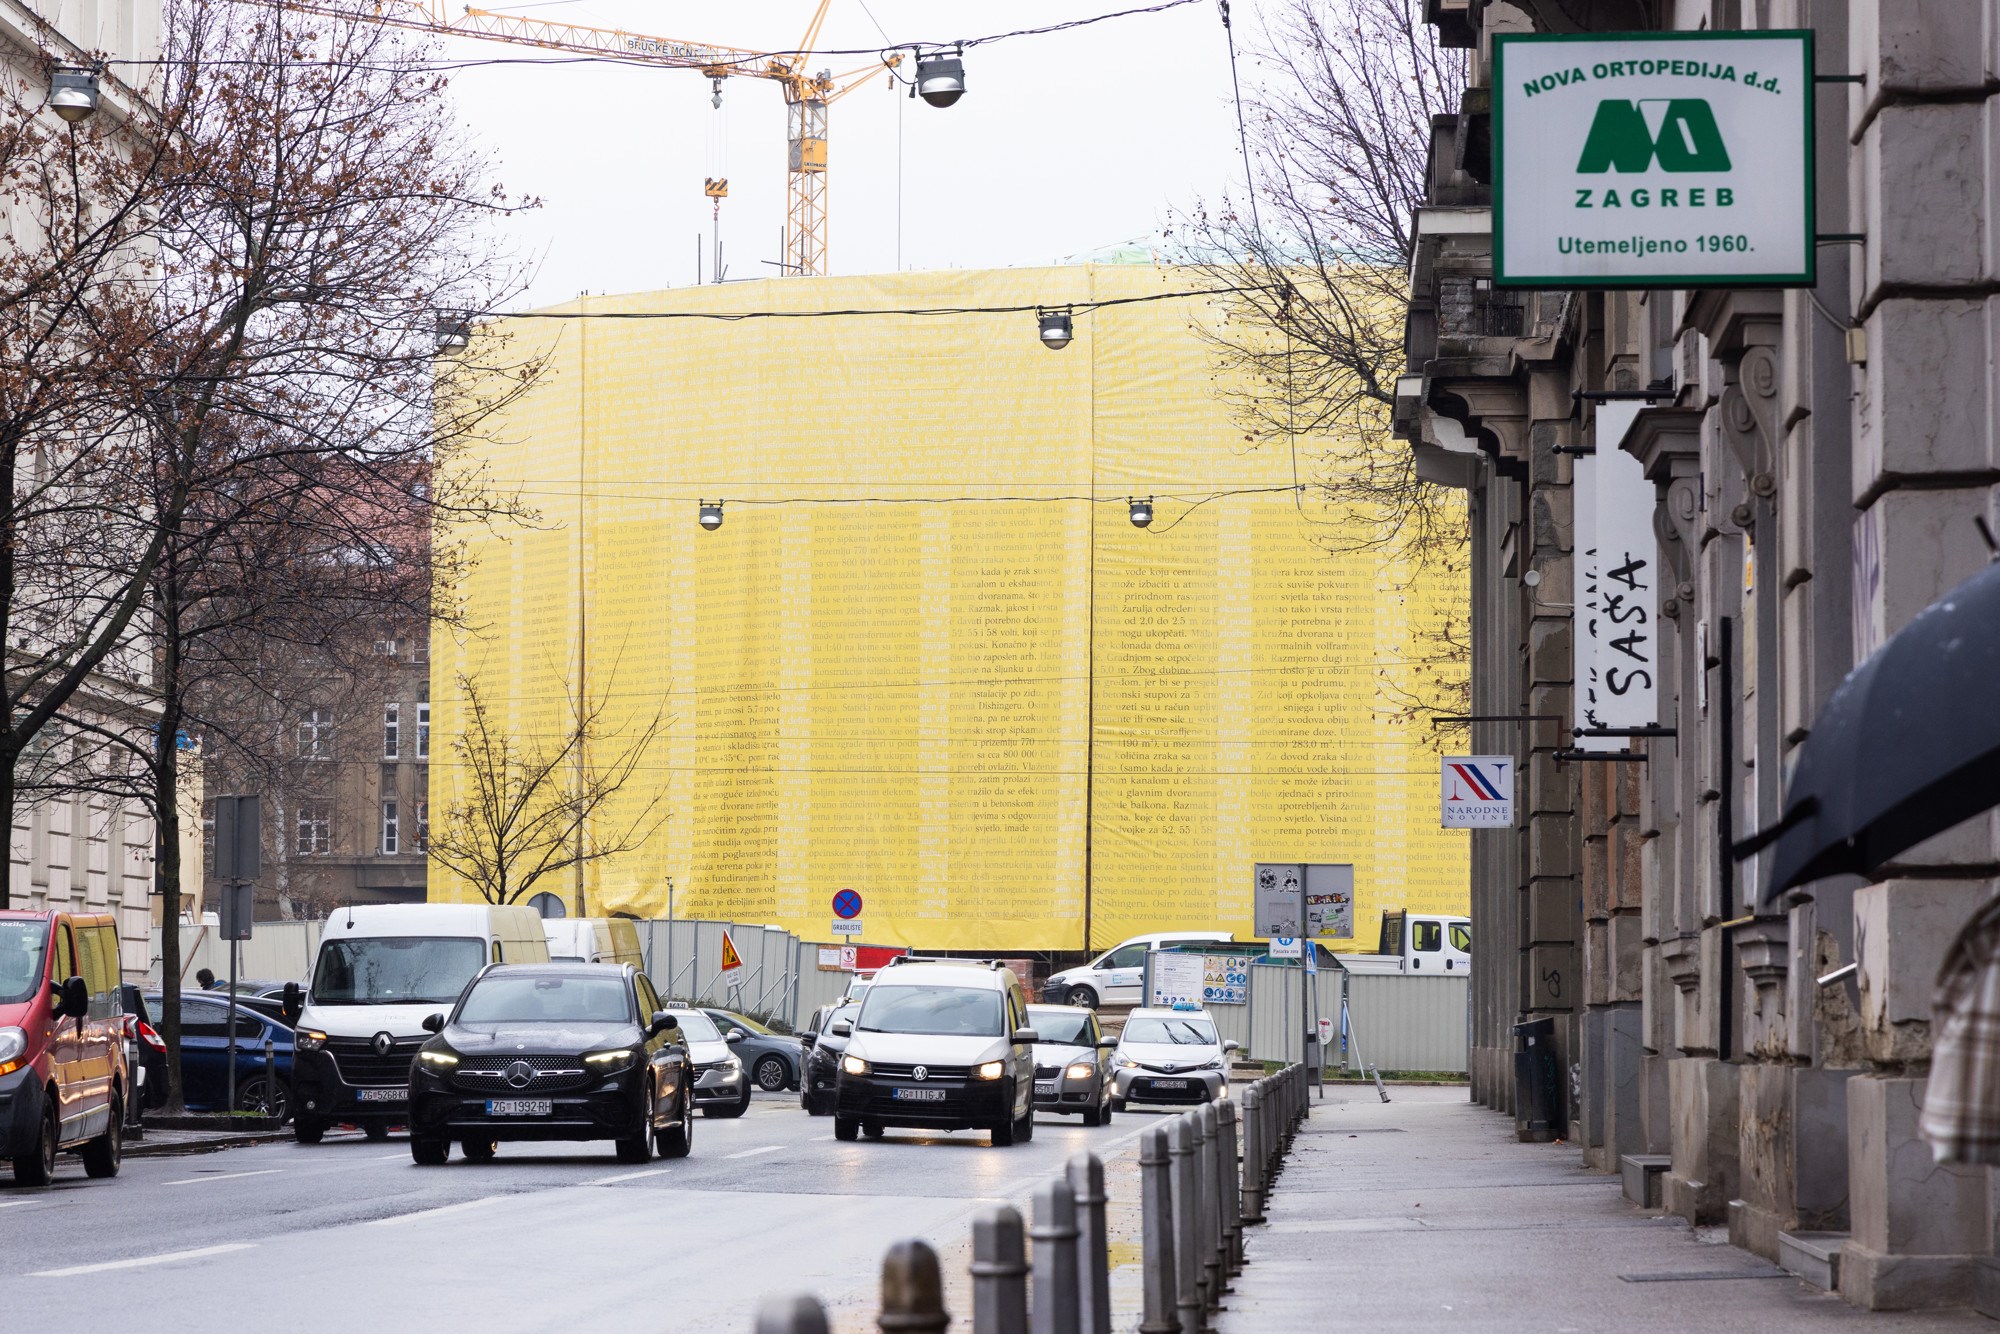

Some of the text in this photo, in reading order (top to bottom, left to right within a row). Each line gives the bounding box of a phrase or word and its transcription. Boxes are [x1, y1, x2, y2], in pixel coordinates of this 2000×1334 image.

[1523, 60, 1782, 97] NOVA ORTOPEDIJA d.d.
[1575, 188, 1734, 208] ZAGREB
[1558, 234, 1755, 257] Utemeljeno 1960.
[981, 567, 1030, 575] kada zrak
[1125, 567, 1170, 577] vode koju
[1294, 568, 1345, 576] kroz sistem
[961, 579, 996, 587] kanalom
[1112, 579, 1170, 587] može izbaciti
[1286, 580, 1355, 590] suviše pokvaren
[978, 590, 1040, 601] dvoranama, što
[1124, 592, 1173, 602] prirodnom
[1281, 592, 1332, 602] svjetla tako
[968, 603, 1029, 614] Razmak, jakost
[1122, 604, 1152, 614] žarulja
[1291, 605, 1343, 613] tako vrsta
[984, 616, 1021, 626] potrebno
[1291, 617, 1331, 627] potrebna
[1601, 552, 1652, 696] SAŠA
[1022, 627, 1038, 638] koji
[1117, 629, 1187, 639] mogu ukopčati.
[1261, 629, 1334, 638] kružna dvorana
[991, 640, 1027, 648] Konačno
[1110, 641, 1181, 649] kolonada doma
[1265, 641, 1370, 650] normalnih volframovih
[983, 653, 1036, 663] zaposlen arh.
[1106, 653, 1208, 663] Gradnjom otpočelo
[1271, 654, 1361, 664] Razmjerno dugi rok
[994, 664, 1024, 675] šljunku
[1132, 665, 1191, 675] Zbog dubine
[1279, 666, 1350, 674] došlo obzir
[1144, 678, 1156, 688] jer
[1301, 678, 1347, 689] podrumu,
[969, 689, 1008, 699] instalacije
[1102, 690, 1177, 700] betonski stupovi
[1115, 702, 1190, 710] uzeti račun
[1283, 703, 1347, 713] snijega upliv
[1013, 713, 1049, 724] uzrokuje
[1287, 715, 1349, 725] svodova obiju
[986, 726, 1043, 736] strop šipkama
[1118, 727, 1137, 737] koje
[1256, 727, 1337, 736] ubetonirane doze.
[1003, 750, 1018, 758] 800
[1021, 750, 1037, 758] 000
[1114, 752, 1178, 760] količina zraka
[1280, 752, 1363, 760] dovod zraka služe
[1022, 762, 1057, 772] Vlaženje
[1120, 764, 1173, 774] (samo kada
[978, 774, 1030, 784] zatim prolazi
[1130, 776, 1170, 784] kanalom
[1294, 776, 1353, 785] može izbaciti
[1126, 788, 1163, 798] glavnim
[1275, 789, 1373, 799] izjednači prirodnom
[720, 801, 754, 809] dvorane
[990, 799, 1034, 807] betonskom
[1277, 801, 1370, 812] upotrebljenih žarulja
[1134, 813, 1197, 823] koje davati
[1285, 814, 1347, 824] svjetlo. Visina
[1004, 823, 1029, 831] imade
[1110, 825, 1146, 835] odvojke
[1273, 826, 1367, 836] prema potrebi mogu
[712, 838, 741, 848] studija
[1170, 850, 1209, 860] zaposlen
[716, 861, 743, 869] terena
[1180, 862, 1213, 873] šljunku
[1179, 899, 1212, 907] vlastite
[362, 1090, 372, 1100] ZG
[898, 1089, 908, 1099] ZG
[493, 1101, 551, 1112] ZG 1992-RH
